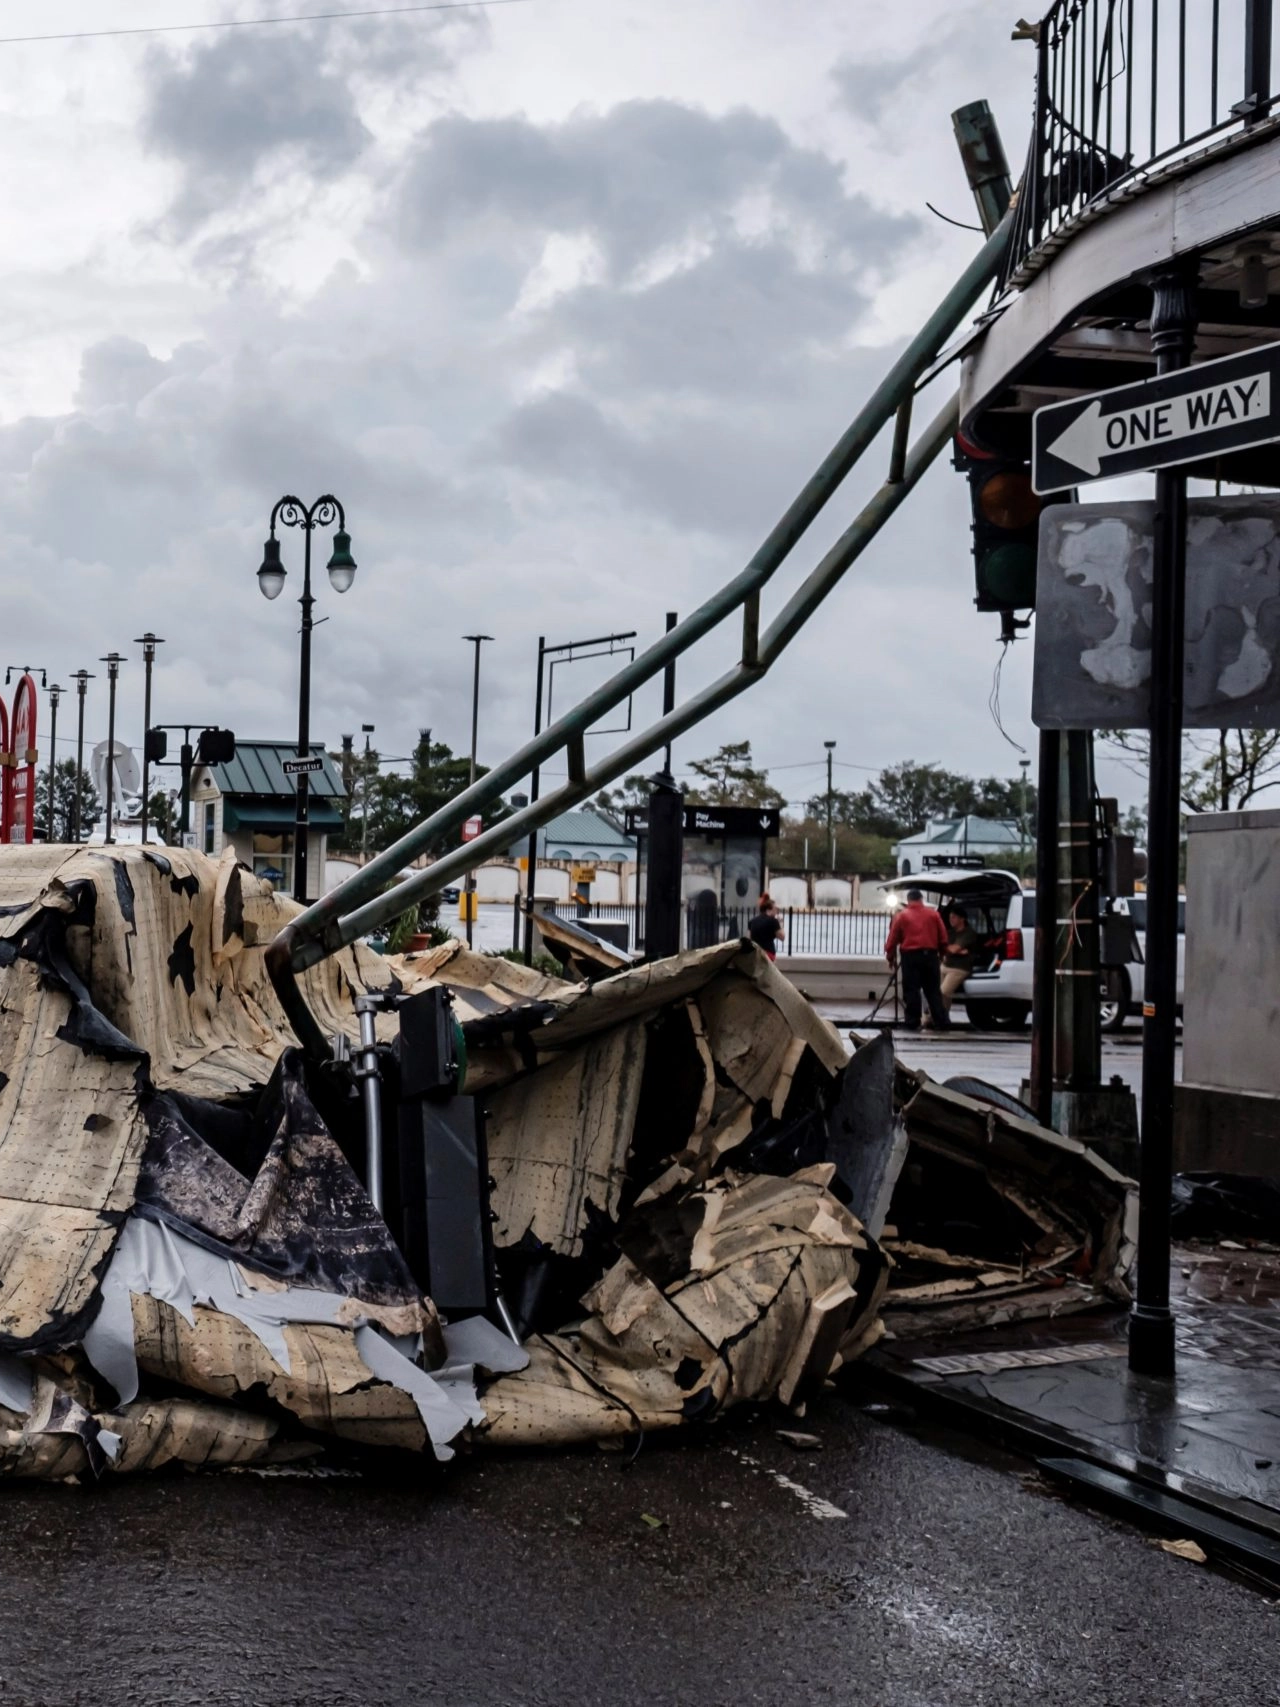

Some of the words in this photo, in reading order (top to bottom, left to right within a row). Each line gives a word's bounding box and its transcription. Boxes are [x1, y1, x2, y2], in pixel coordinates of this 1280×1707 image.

[1106, 404, 1173, 450] ONE
[1186, 380, 1260, 430] WAY
[286, 763, 321, 773] Decatur
[695, 812, 710, 822] Pay
[695, 819, 726, 830] Machine
